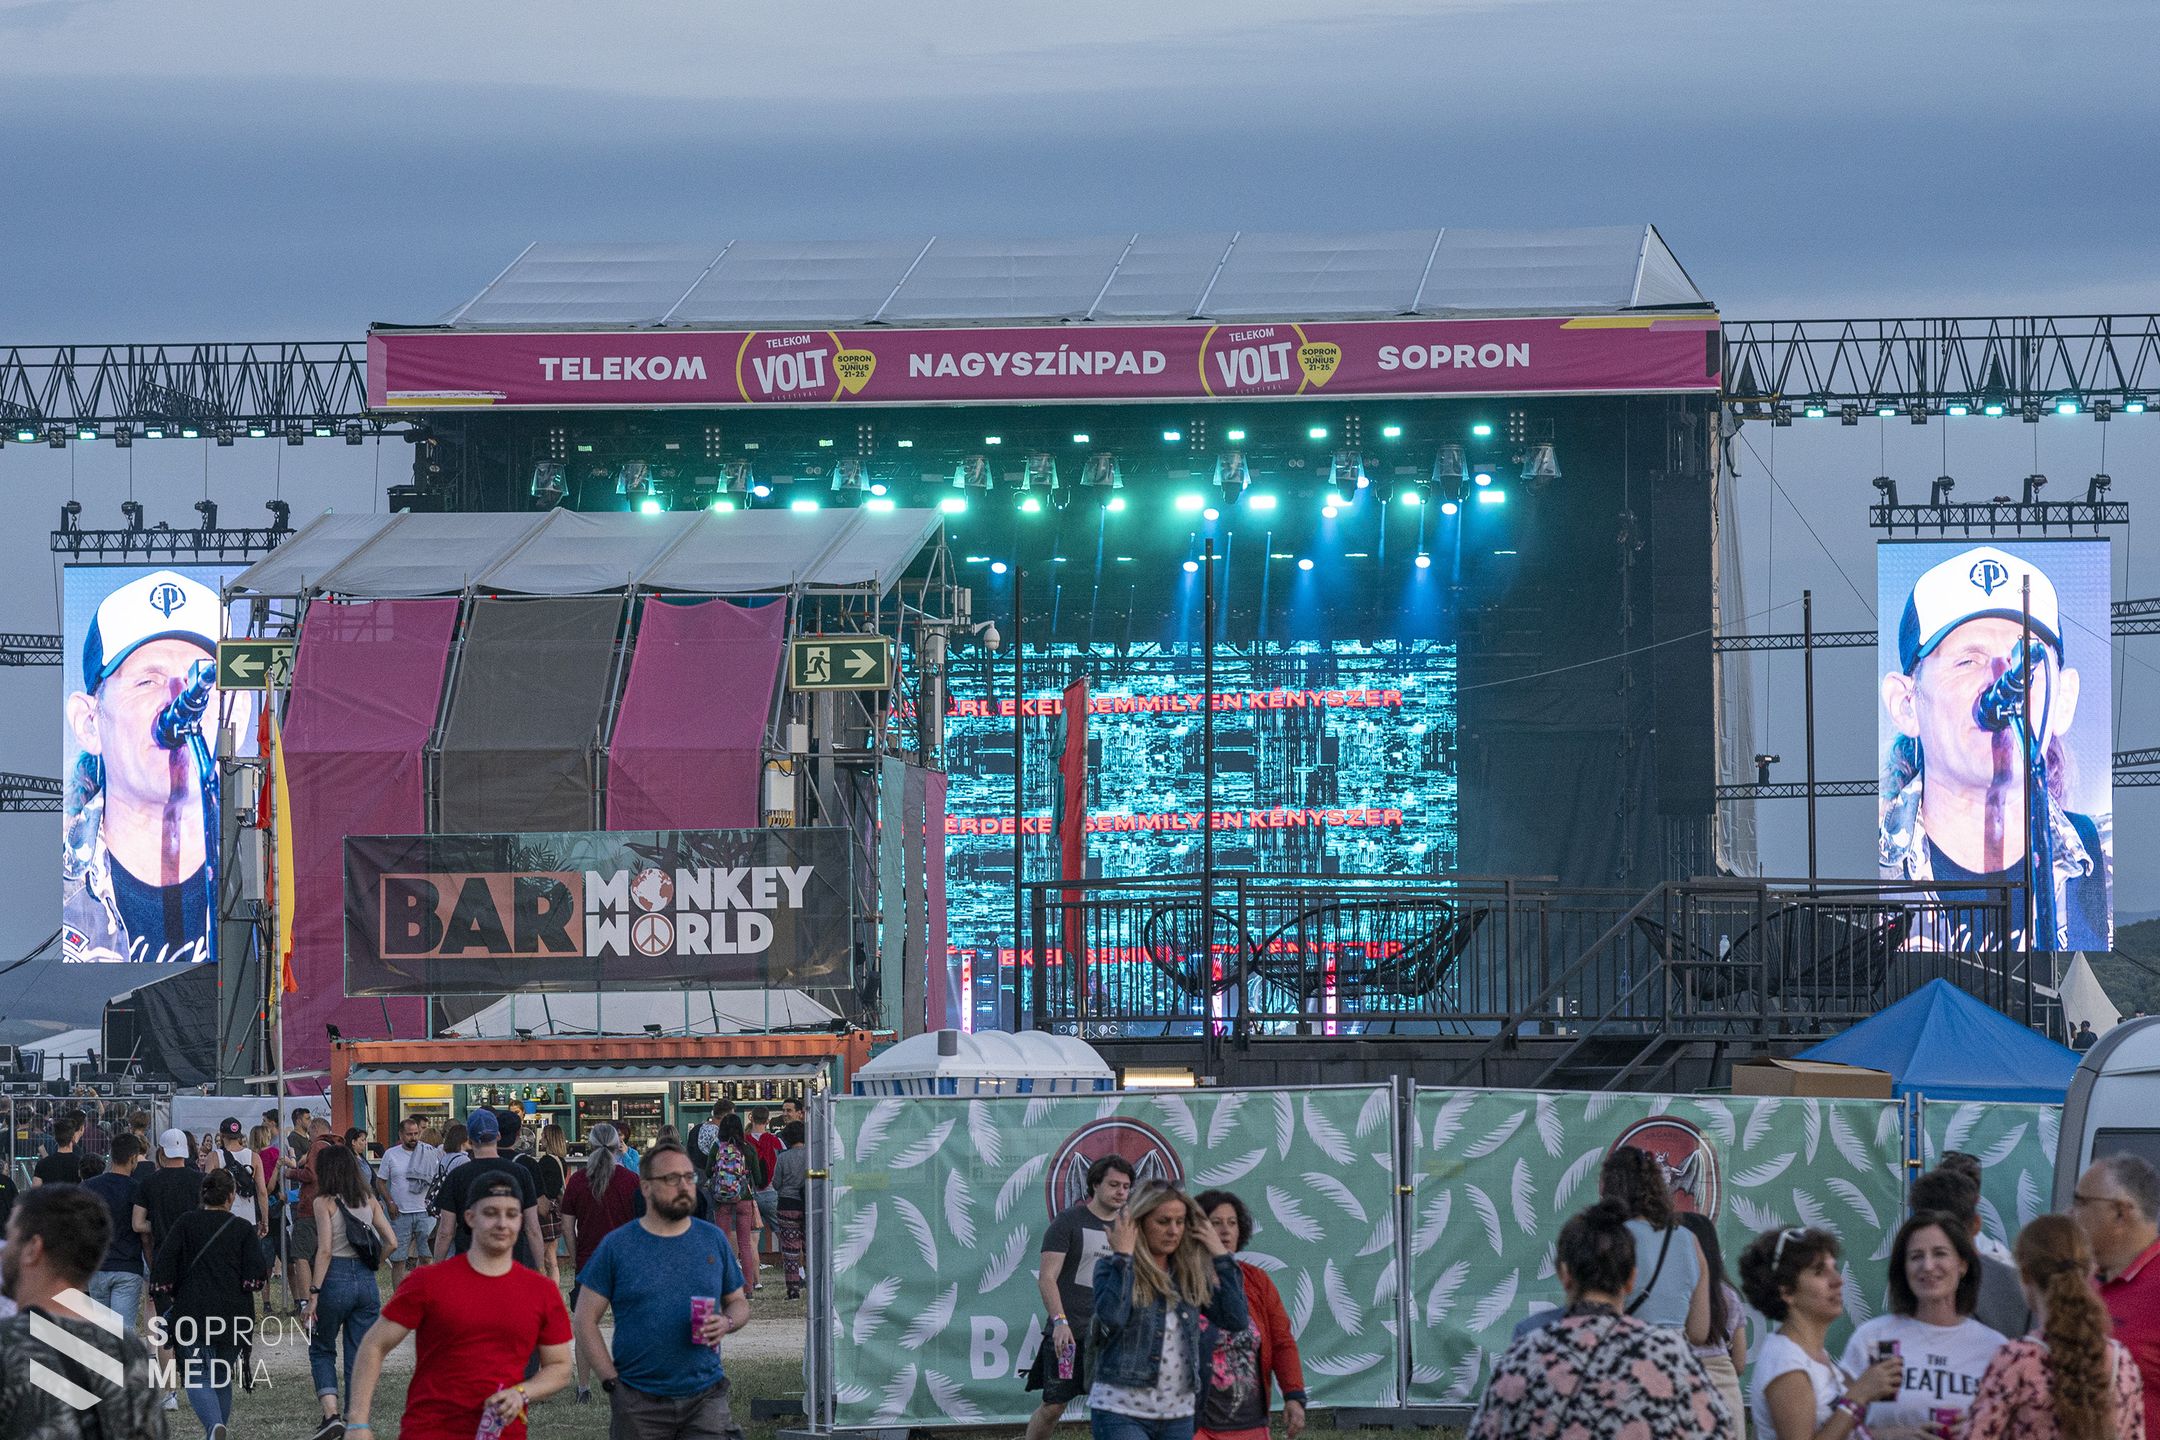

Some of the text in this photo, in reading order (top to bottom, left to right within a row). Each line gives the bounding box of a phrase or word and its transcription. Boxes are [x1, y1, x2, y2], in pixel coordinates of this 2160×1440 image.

[766, 335, 811, 349] TELEKOM
[1229, 328, 1274, 342] TELEKOM
[539, 343, 1530, 382] TELEKOM NAGYSZÍNPAD SOPRON
[752, 348, 828, 394] VOLT
[837, 355, 872, 363] SOPRON
[839, 362, 869, 371] JÚNIUS
[1215, 342, 1292, 388] VOLT
[1304, 355, 1334, 364] JÚNIUS
[1250, 687, 1403, 710] KÉNYSZER
[944, 813, 1053, 834] ÉRDEKE
[1250, 806, 1403, 828] KÉNYSZER
[585, 865, 815, 912] MONKEY
[384, 876, 578, 956] BAR
[585, 912, 774, 957] WORLD
[1926, 1354, 1947, 1366] THE
[1905, 1367, 1983, 1399] EATLES
